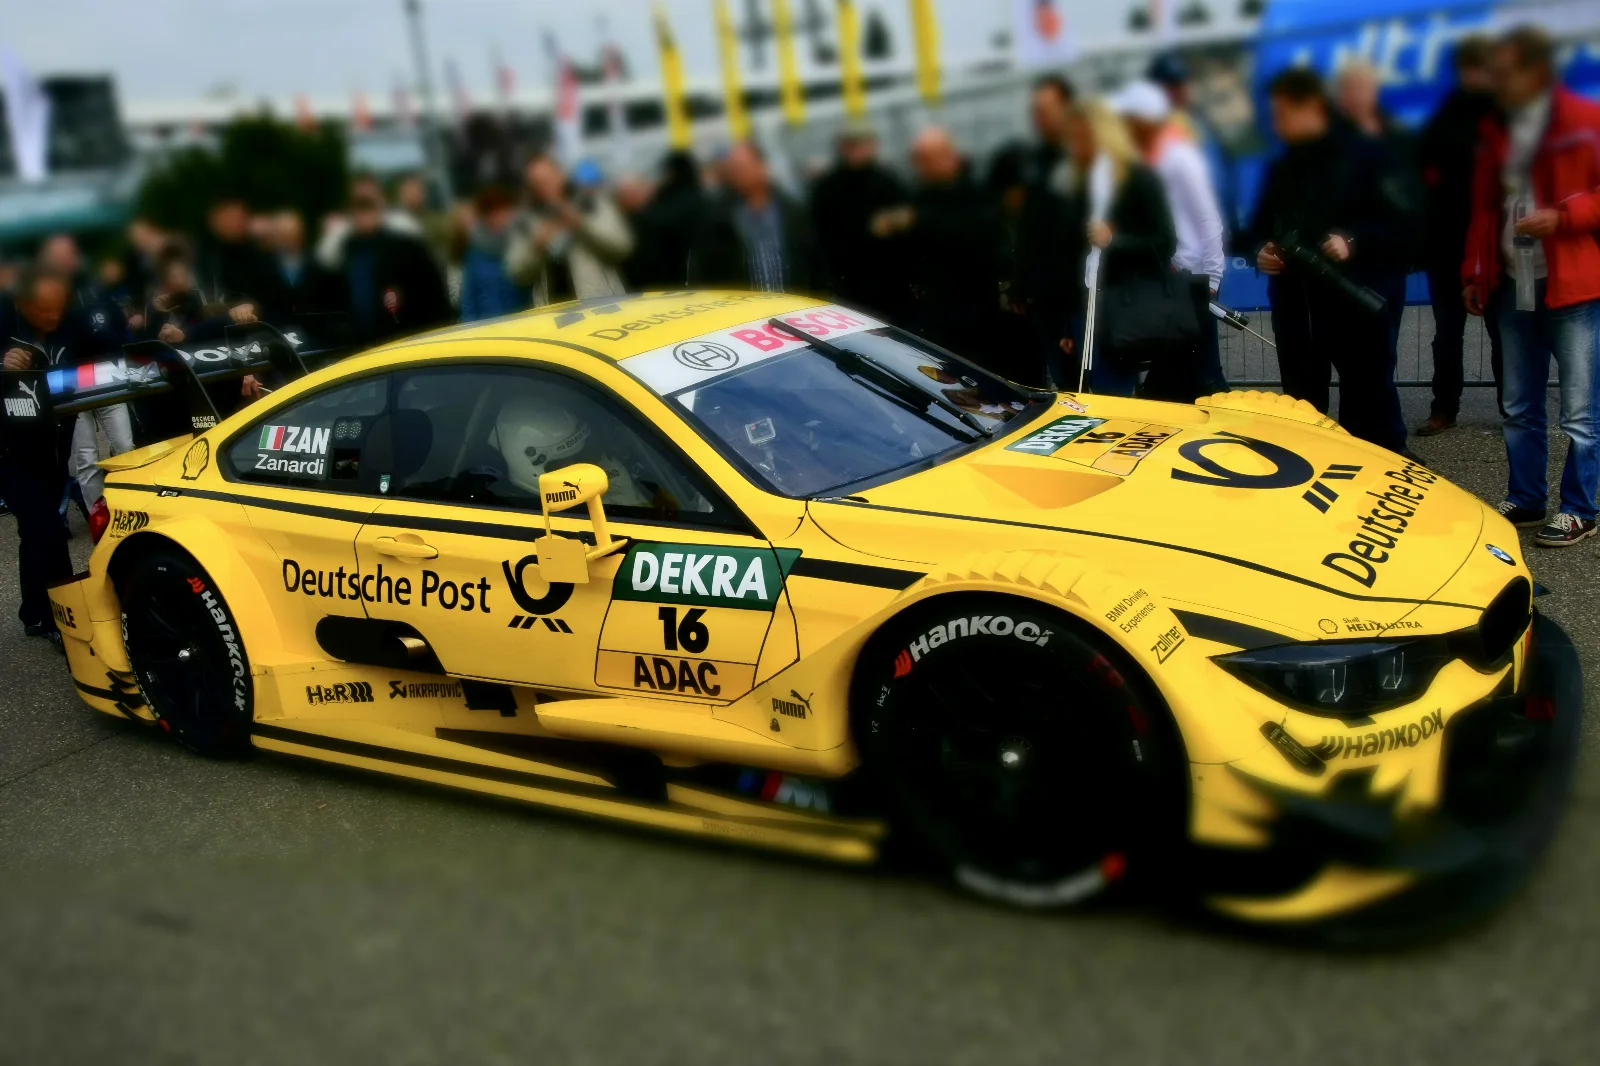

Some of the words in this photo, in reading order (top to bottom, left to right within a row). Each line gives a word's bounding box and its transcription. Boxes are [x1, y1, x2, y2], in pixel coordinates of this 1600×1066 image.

[728, 309, 866, 353] BOSCH
[4, 398, 37, 418] PUMA
[282, 426, 331, 455] ZAN
[1014, 417, 1099, 451] DEKRA
[1073, 431, 1127, 445] 16
[1110, 431, 1170, 459] ADAC
[255, 453, 324, 475] Zanardi
[545, 489, 577, 504] PUMA
[1320, 484, 1425, 589] Deutsche
[1384, 459, 1438, 492] Post
[282, 558, 412, 606] Deutsche
[421, 569, 492, 614] Post
[631, 550, 768, 600] DEKRA
[1105, 601, 1128, 623] BMW
[1122, 588, 1149, 607] Driving
[1119, 602, 1157, 634] Experience
[1342, 616, 1361, 624] Shell
[658, 606, 710, 654] 16
[1346, 622, 1384, 633] HELIX
[1385, 620, 1423, 630] ULTRA
[634, 655, 721, 697] ADAC
[771, 698, 807, 719] PUMA
